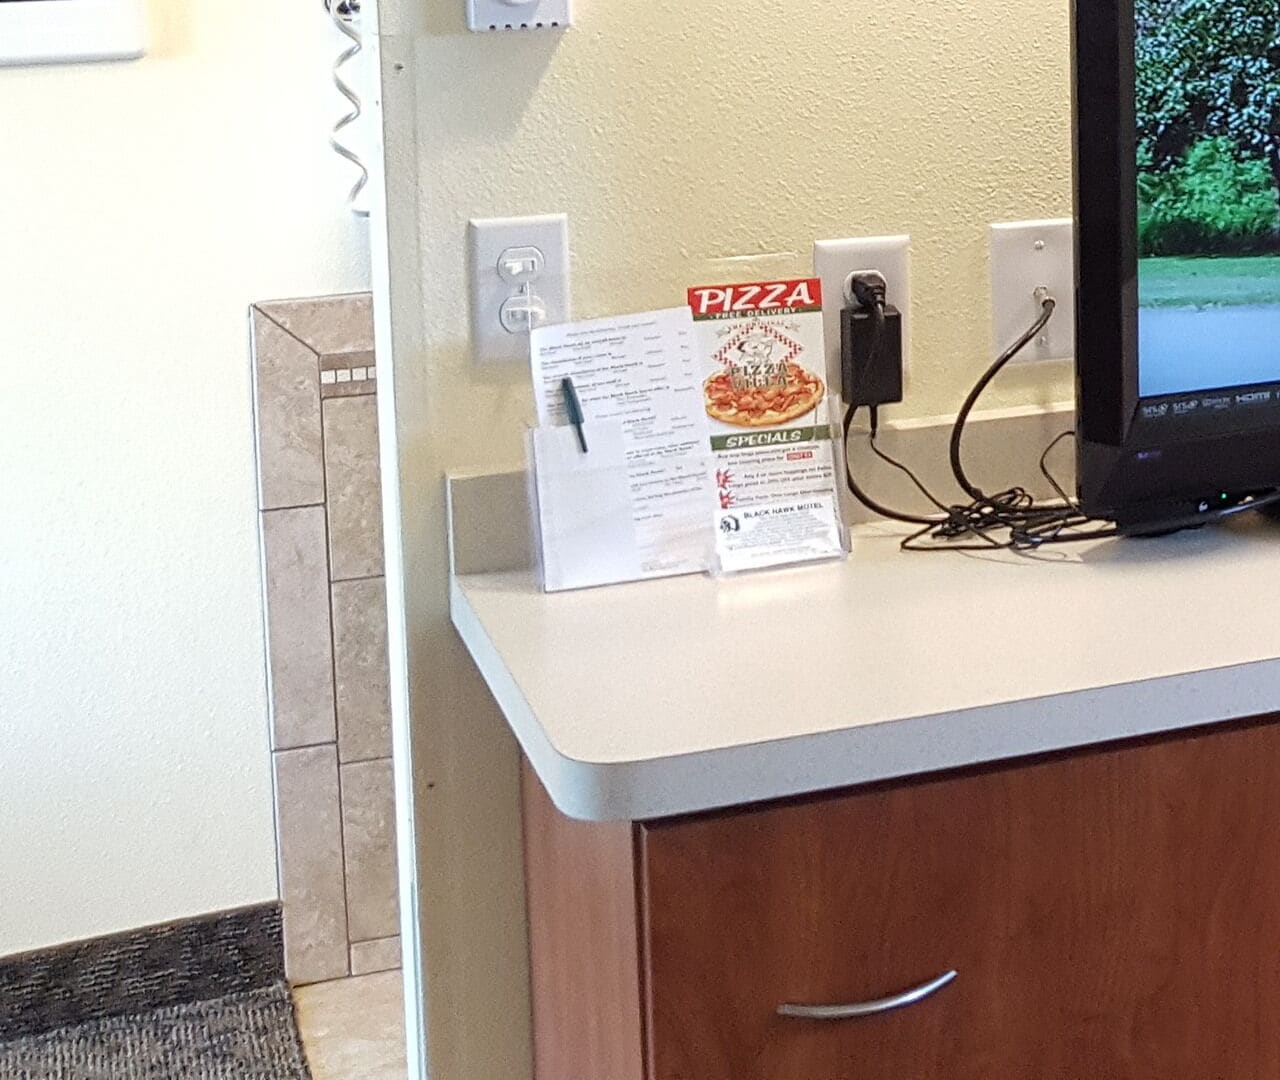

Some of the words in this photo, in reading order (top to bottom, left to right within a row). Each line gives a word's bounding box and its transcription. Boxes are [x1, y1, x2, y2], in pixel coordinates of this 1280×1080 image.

[694, 282, 814, 314] PIZZA
[716, 311, 743, 319] FREE
[748, 307, 796, 317] DELIVERY
[726, 431, 801, 448] SPECIALS
[743, 510, 770, 519] BLACK
[772, 506, 795, 515] HAWK
[797, 503, 824, 512] MOTEL
